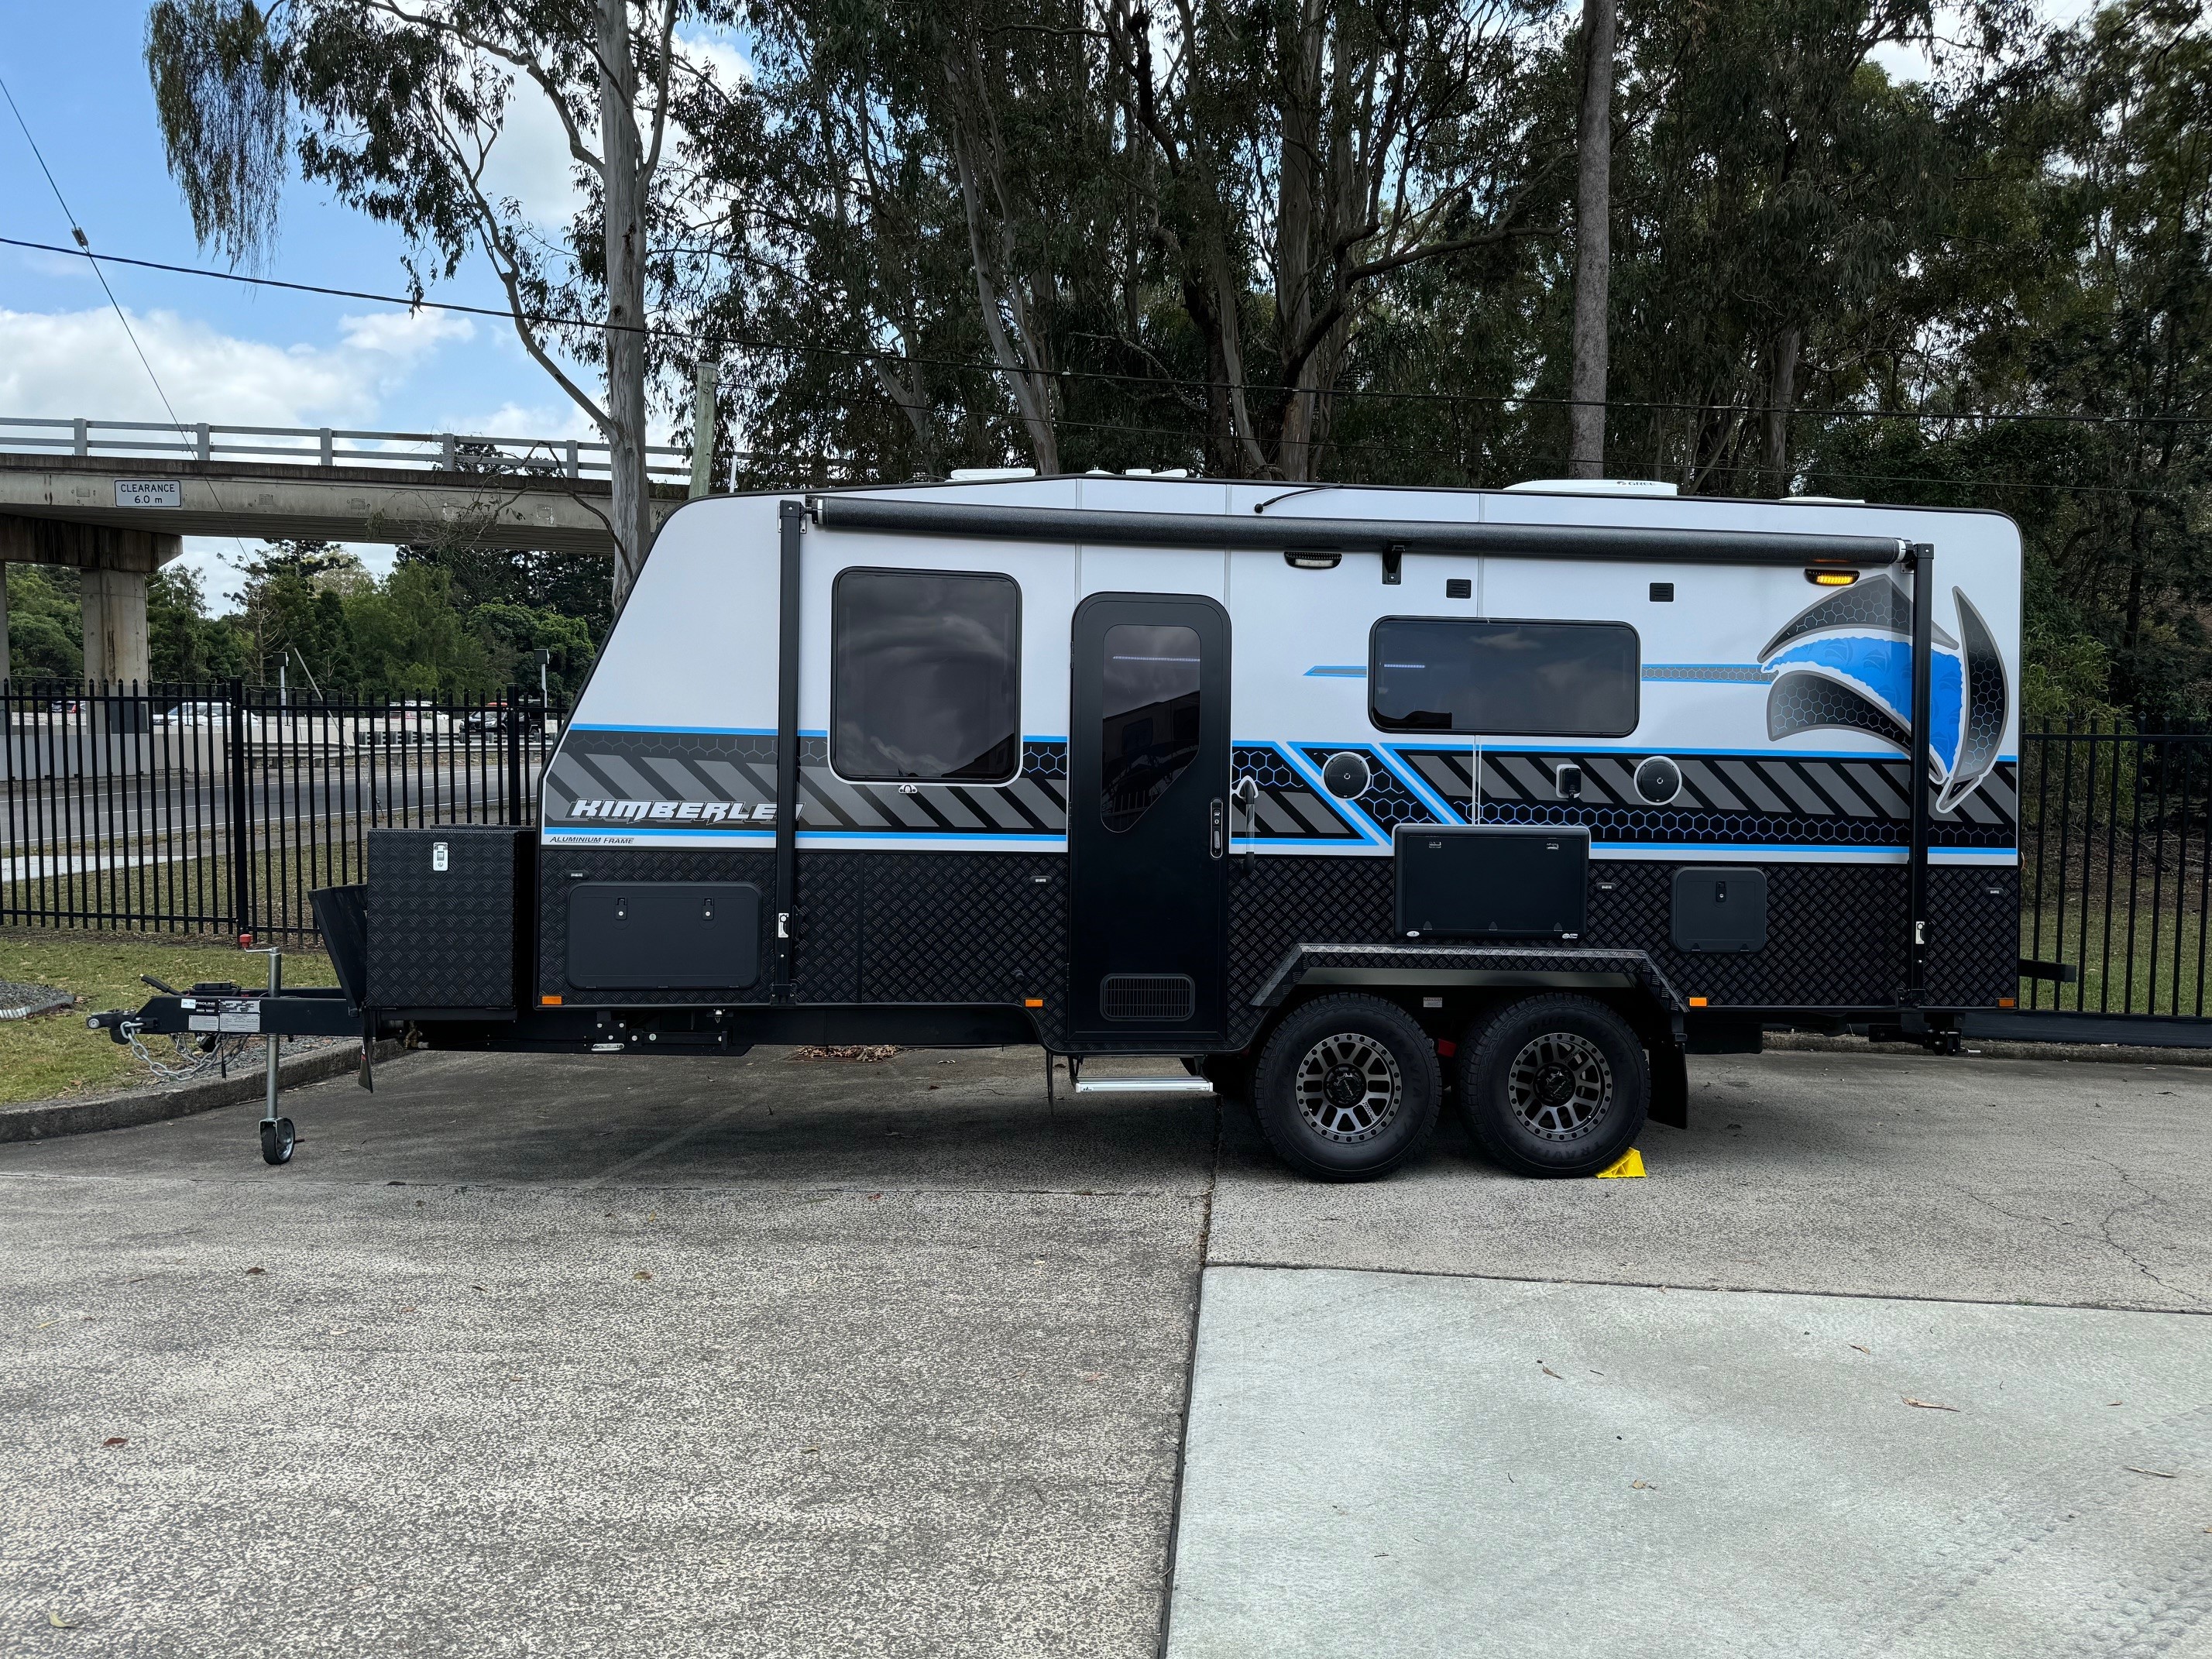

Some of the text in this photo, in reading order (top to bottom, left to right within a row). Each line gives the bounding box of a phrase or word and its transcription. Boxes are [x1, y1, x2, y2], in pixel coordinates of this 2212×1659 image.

[120, 483, 175, 493] CLEARANCE
[134, 495, 150, 504] 6.0
[569, 799, 805, 823] KIMBERLE
